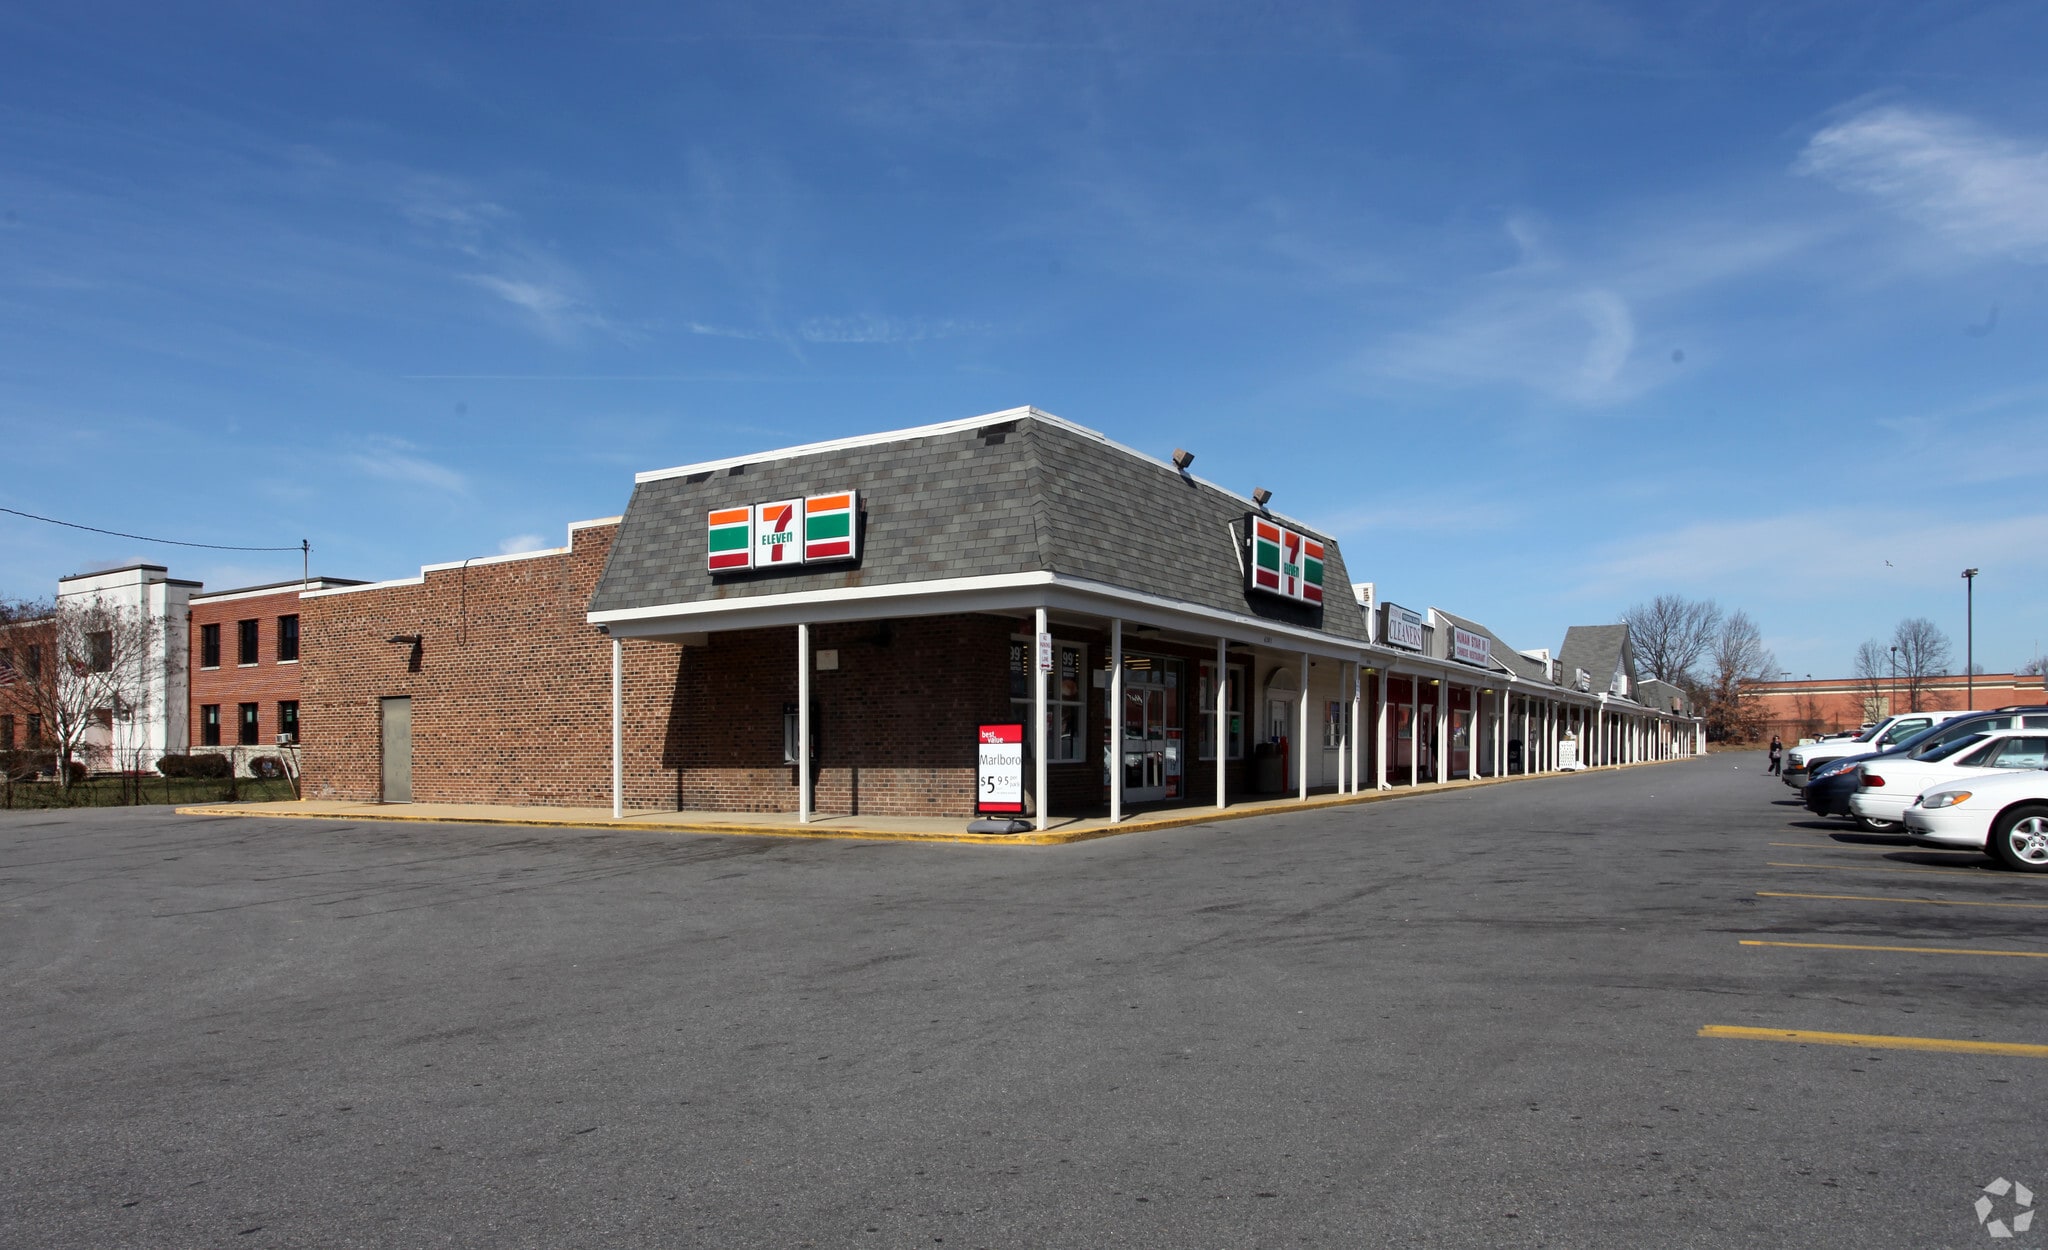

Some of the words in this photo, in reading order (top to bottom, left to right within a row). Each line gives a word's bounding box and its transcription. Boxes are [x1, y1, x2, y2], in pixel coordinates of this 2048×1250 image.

[761, 531, 793, 546] ELEVEN
[763, 504, 793, 562] 7
[1284, 562, 1299, 578] ELEVEN
[1285, 531, 1300, 596] 7
[1389, 619, 1421, 647] CLEANERS
[981, 731, 995, 739] best
[987, 736, 1004, 744] value
[979, 753, 1022, 766] Marlboro
